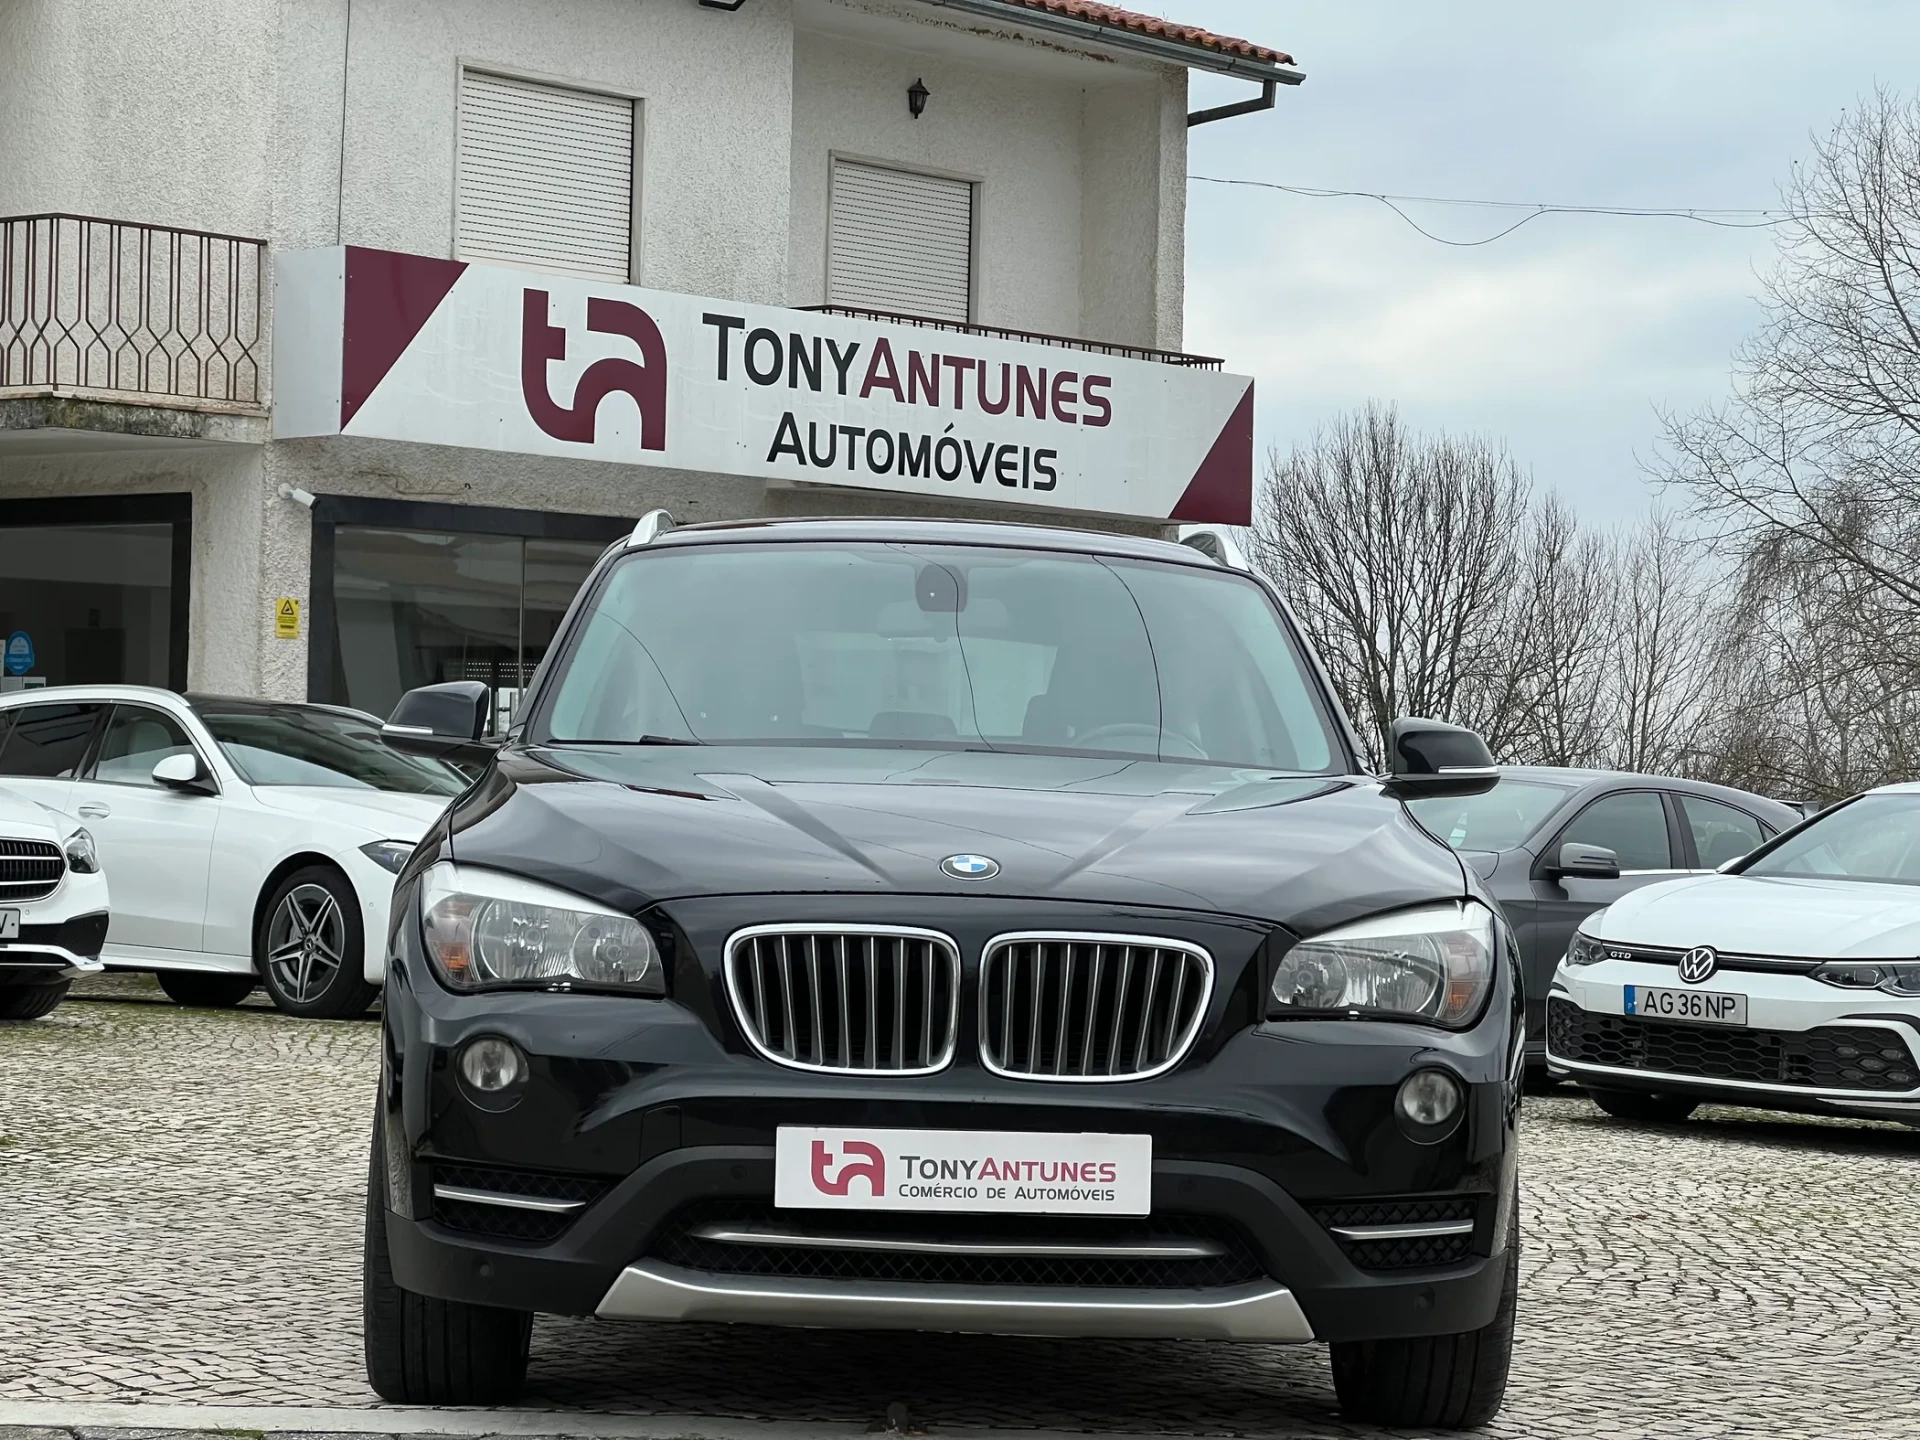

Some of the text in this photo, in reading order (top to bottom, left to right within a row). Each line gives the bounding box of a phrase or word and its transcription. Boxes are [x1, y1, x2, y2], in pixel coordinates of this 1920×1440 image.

[765, 411, 1058, 492] AUTOMÓVEIS
[1610, 950, 1632, 959] GTD
[898, 1182, 1115, 1201] COMÉRCIO DE AUTOMÓVEIS
